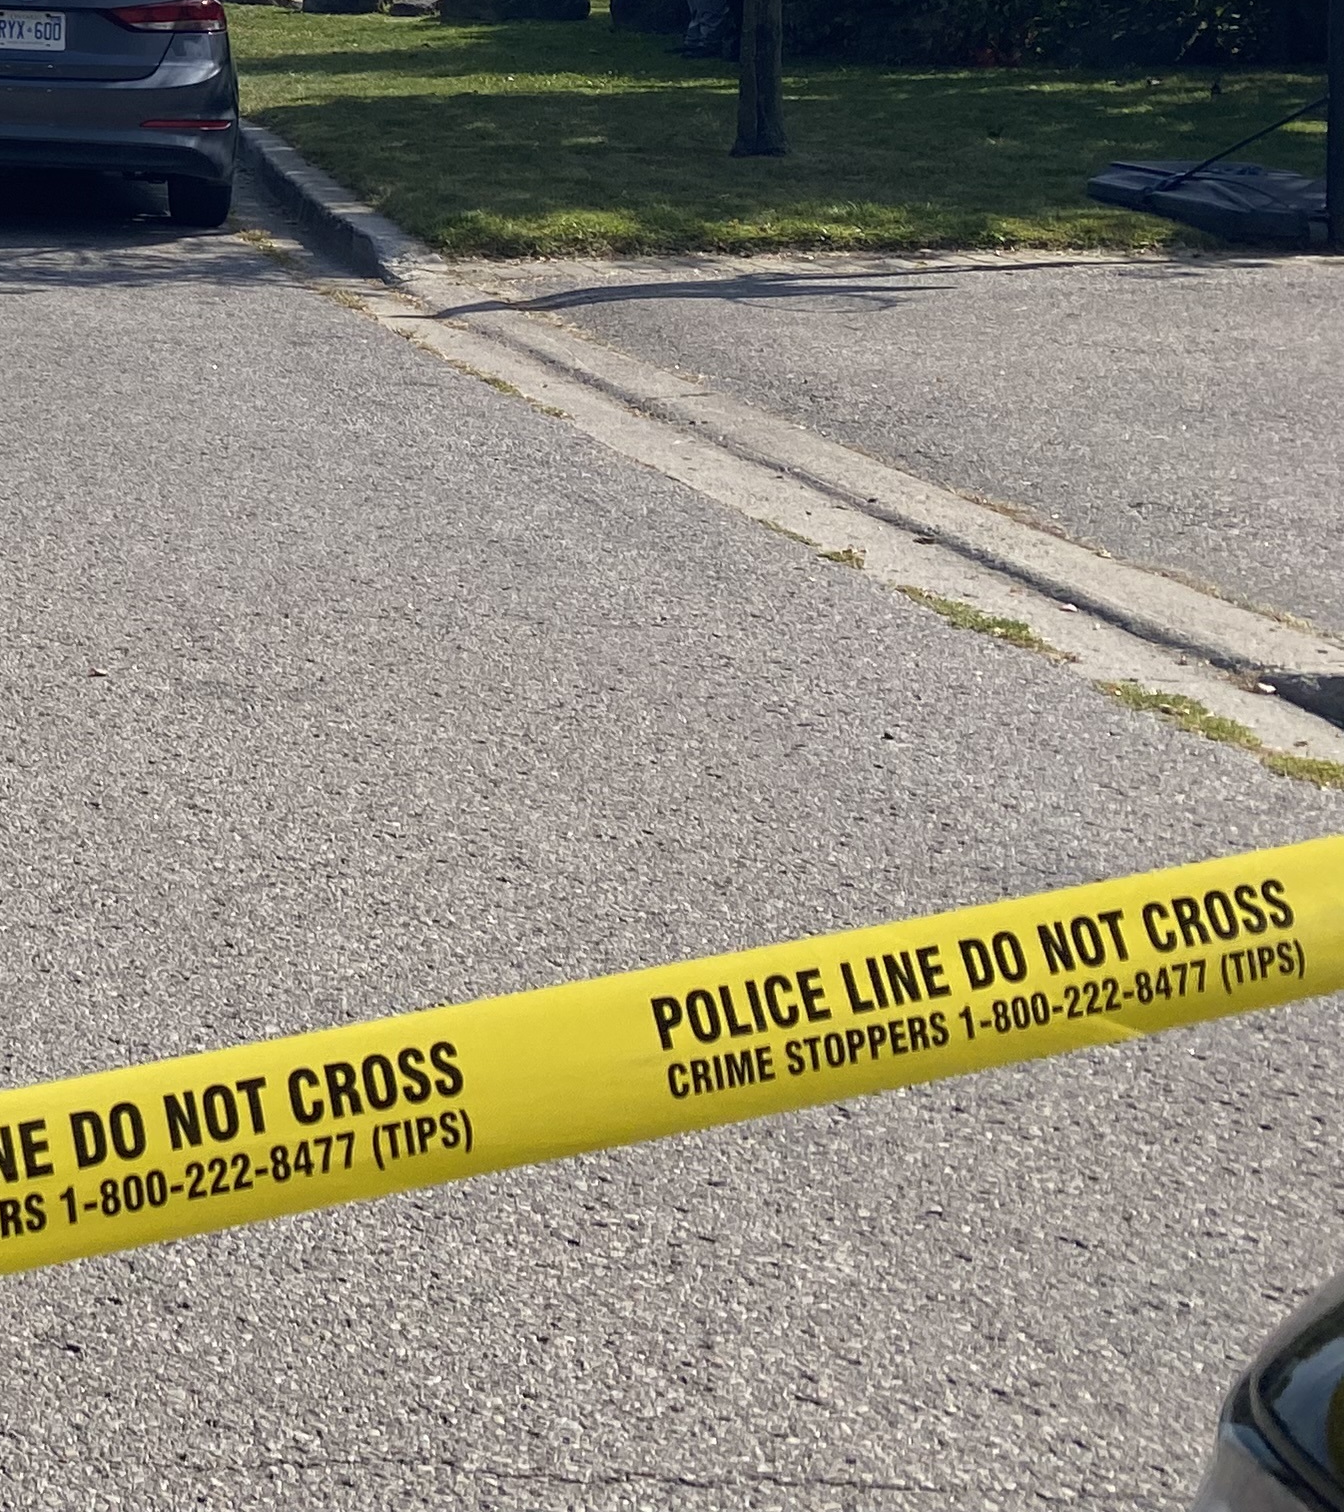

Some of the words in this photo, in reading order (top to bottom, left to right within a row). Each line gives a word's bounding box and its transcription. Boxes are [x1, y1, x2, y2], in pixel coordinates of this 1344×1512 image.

[650, 968, 832, 1051] POLICE
[839, 945, 951, 1015] LINE
[958, 931, 1027, 991] DO
[1036, 909, 1128, 975] NOT
[1142, 879, 1294, 953] CROSS
[667, 1039, 776, 1100] CRIME
[785, 1012, 950, 1076] STOPPERS
[958, 949, 1210, 1040] 1-800-222-8477
[1221, 939, 1305, 995] (TIPS)
[59, 1131, 355, 1225] 1-800-222-8477
[372, 1109, 473, 1172] (TIPS)
[69, 1102, 146, 1170] DO
[163, 1076, 266, 1151] NOT
[288, 1041, 464, 1126] CROSS
